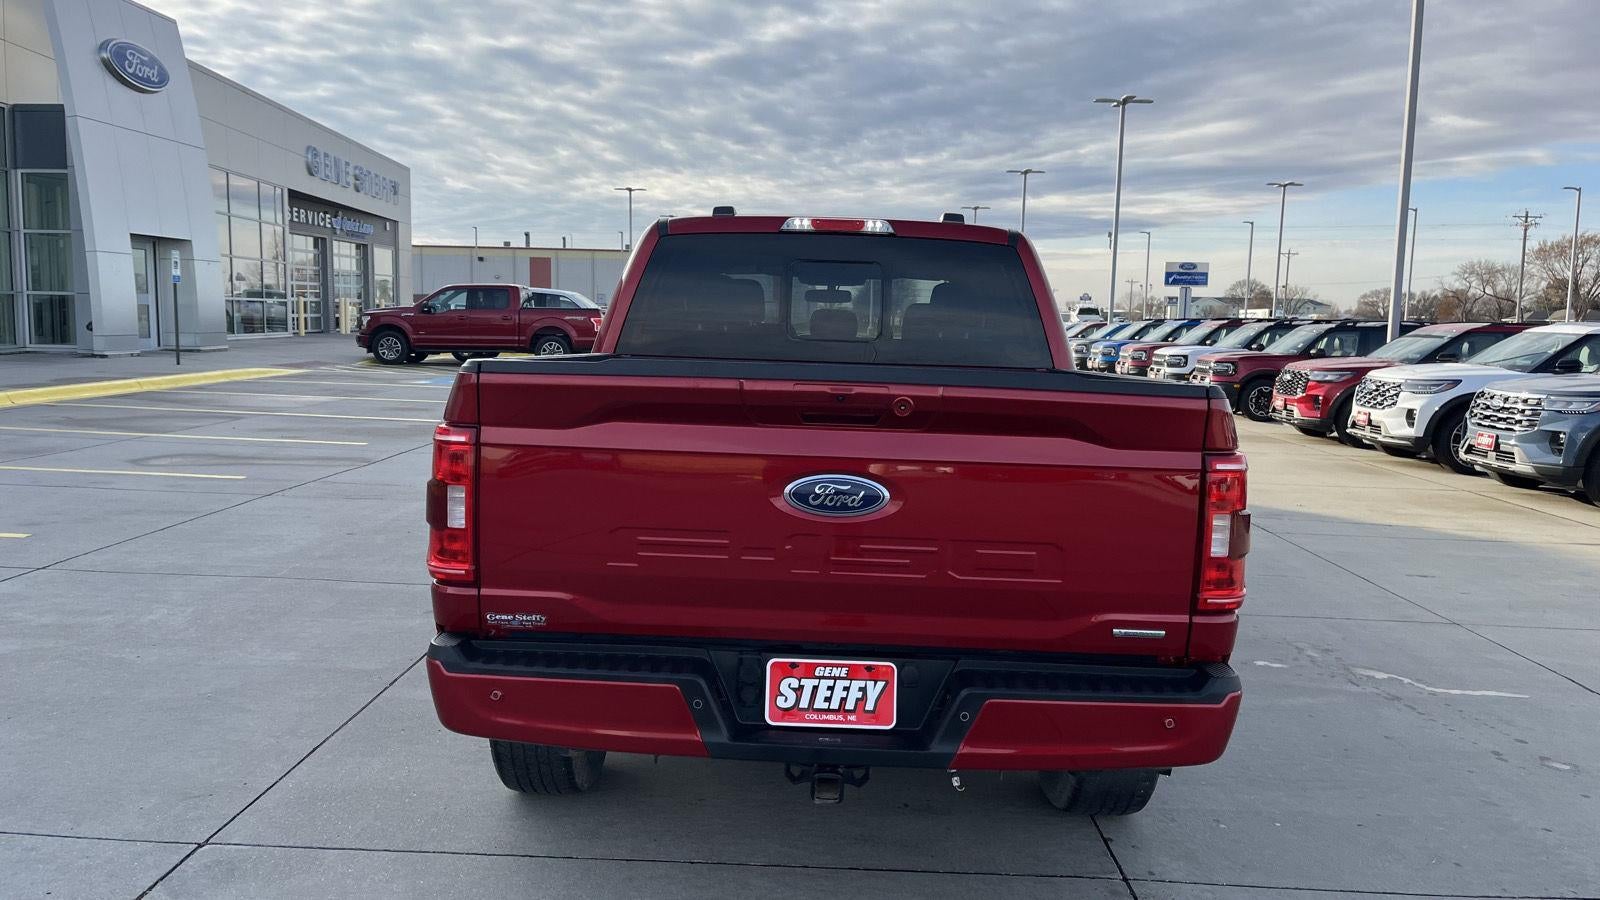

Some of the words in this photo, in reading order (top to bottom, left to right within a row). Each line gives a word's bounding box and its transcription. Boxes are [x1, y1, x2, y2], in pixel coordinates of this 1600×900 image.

[125, 49, 159, 82] Ford
[306, 145, 351, 188] GENE
[809, 483, 865, 507] Ford
[486, 613, 514, 621] Gene
[515, 614, 546, 622] Steffy
[814, 666, 849, 678] GENE
[776, 677, 886, 712] STEFFY
[804, 713, 846, 721] COLUMBUS,
